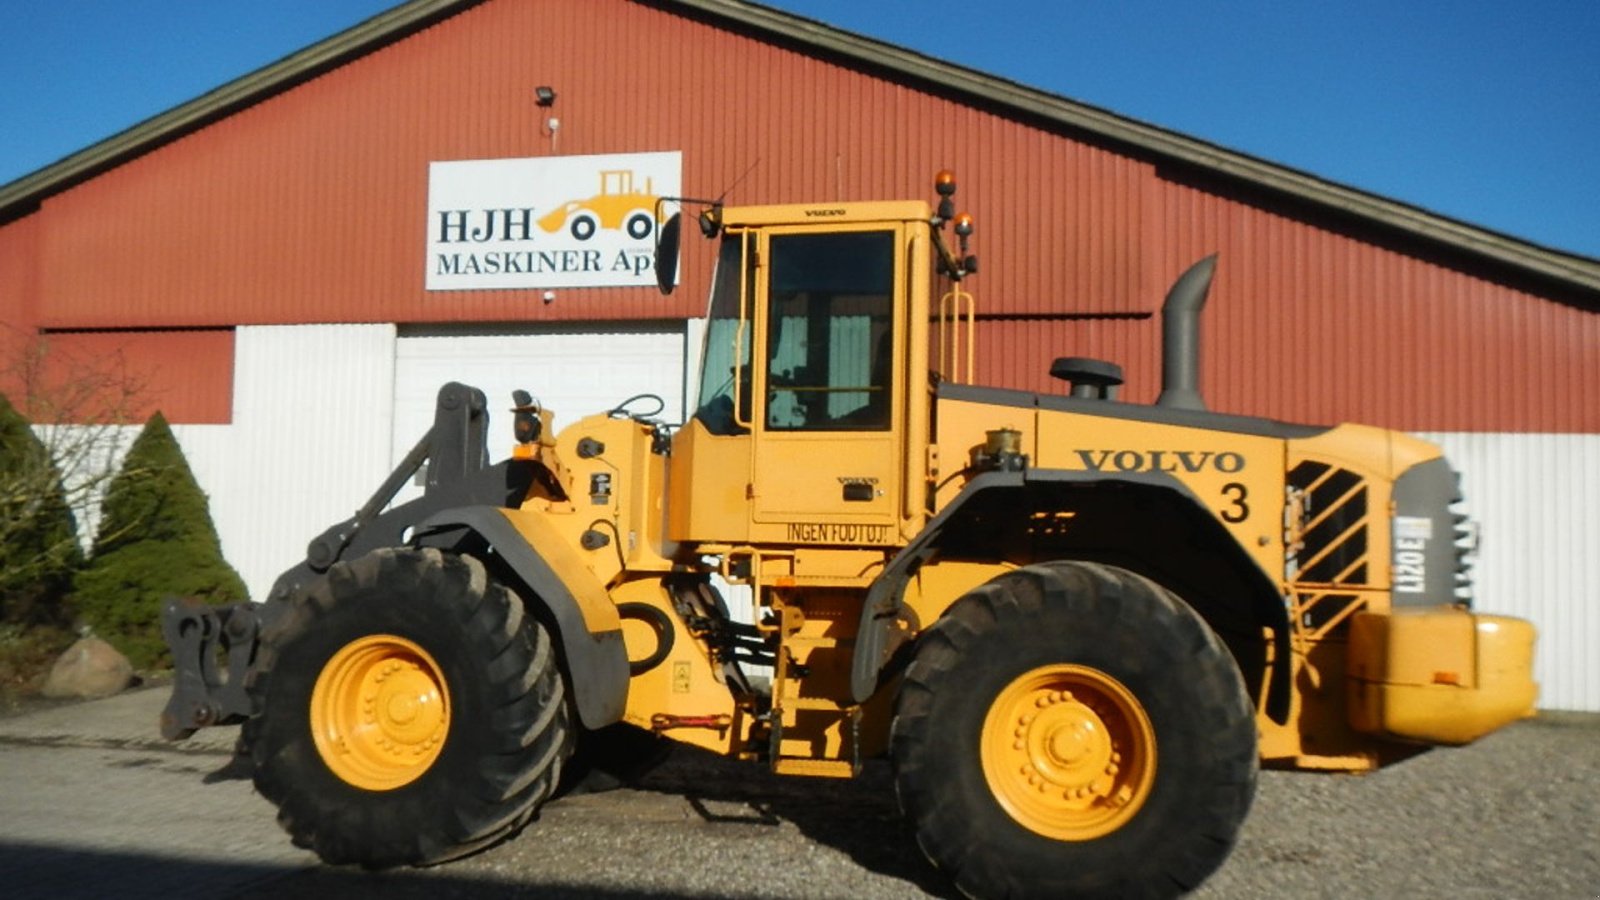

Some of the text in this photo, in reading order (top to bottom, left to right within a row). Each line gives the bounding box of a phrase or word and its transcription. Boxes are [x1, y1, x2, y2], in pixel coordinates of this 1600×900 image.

[436, 207, 535, 243] HJH
[804, 208, 846, 217] VOLVO
[436, 248, 657, 276] MASKINER Ap
[1073, 449, 1246, 473] VOLVO
[1219, 482, 1249, 523] 3
[787, 523, 828, 543] INGEN
